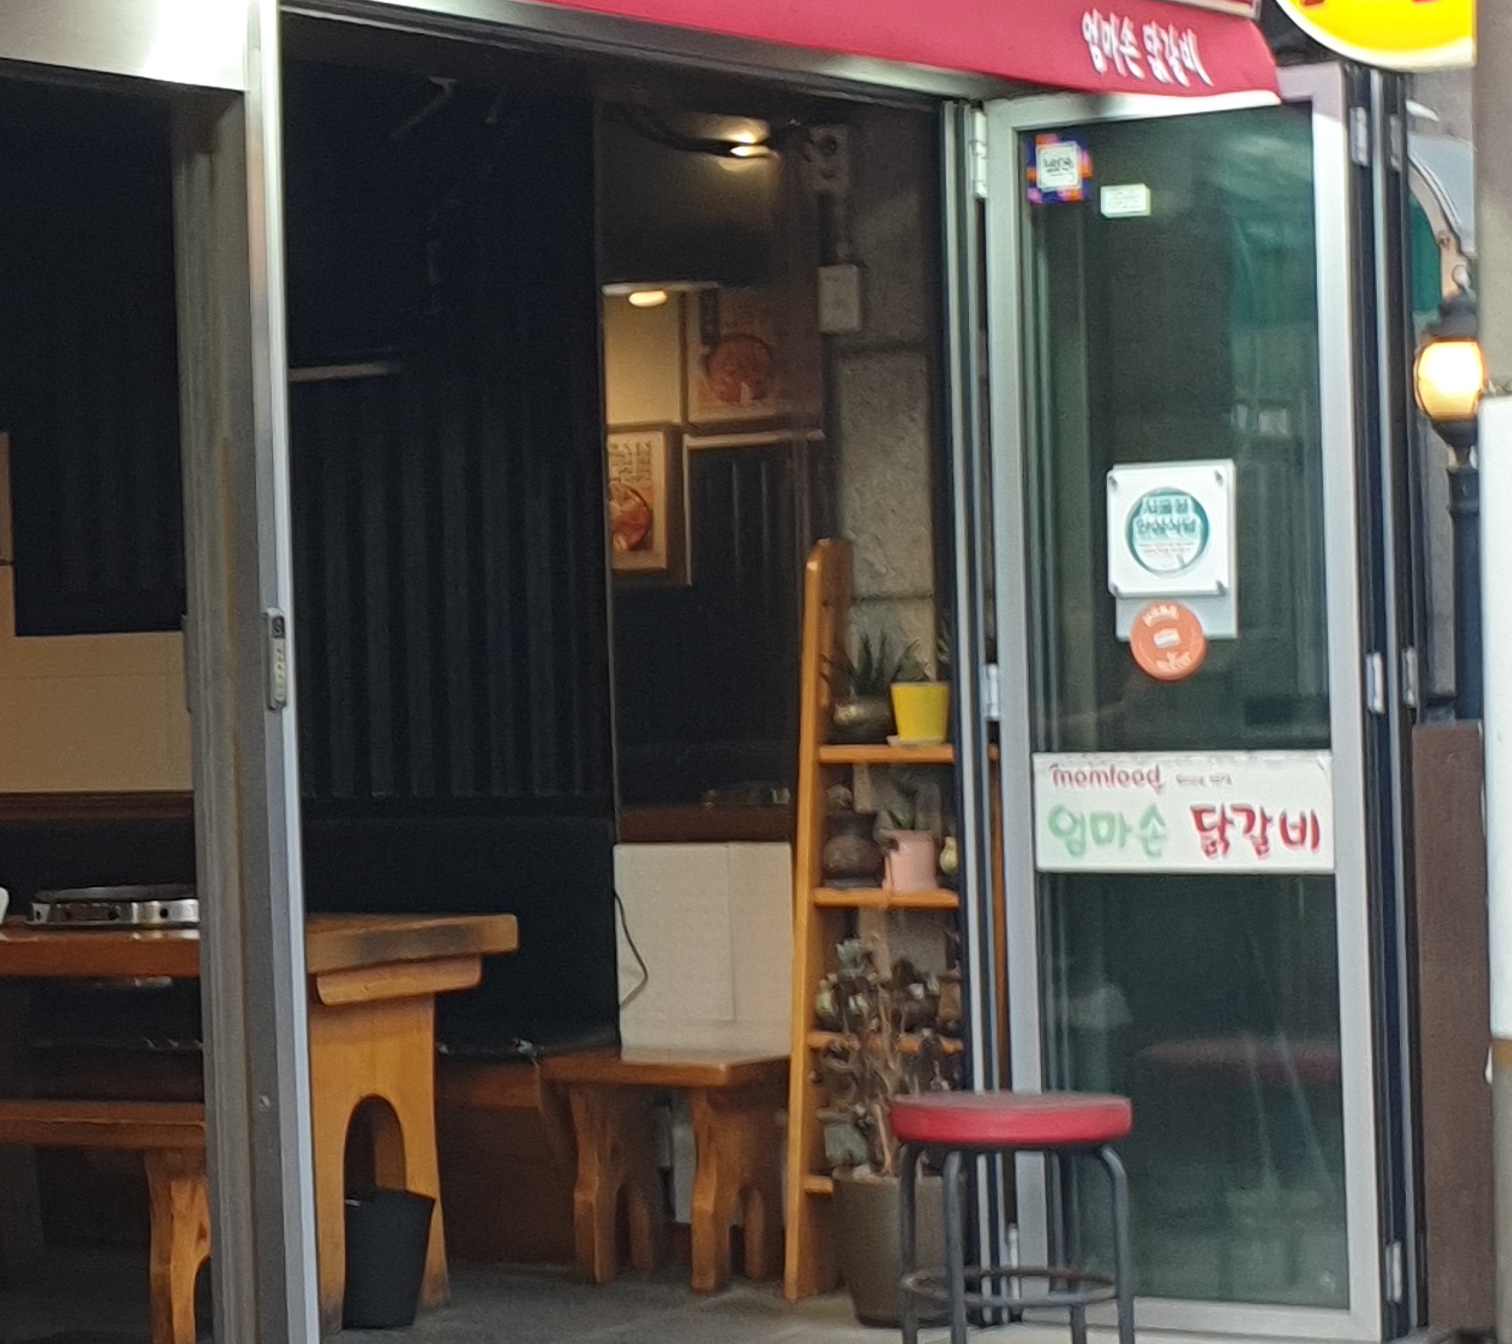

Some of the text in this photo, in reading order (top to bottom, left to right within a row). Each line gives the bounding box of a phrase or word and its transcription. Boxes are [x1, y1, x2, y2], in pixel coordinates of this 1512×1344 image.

[1081, 7, 1146, 81] 엄마손
[1047, 802, 1321, 861] 엄마손 닭갈비
